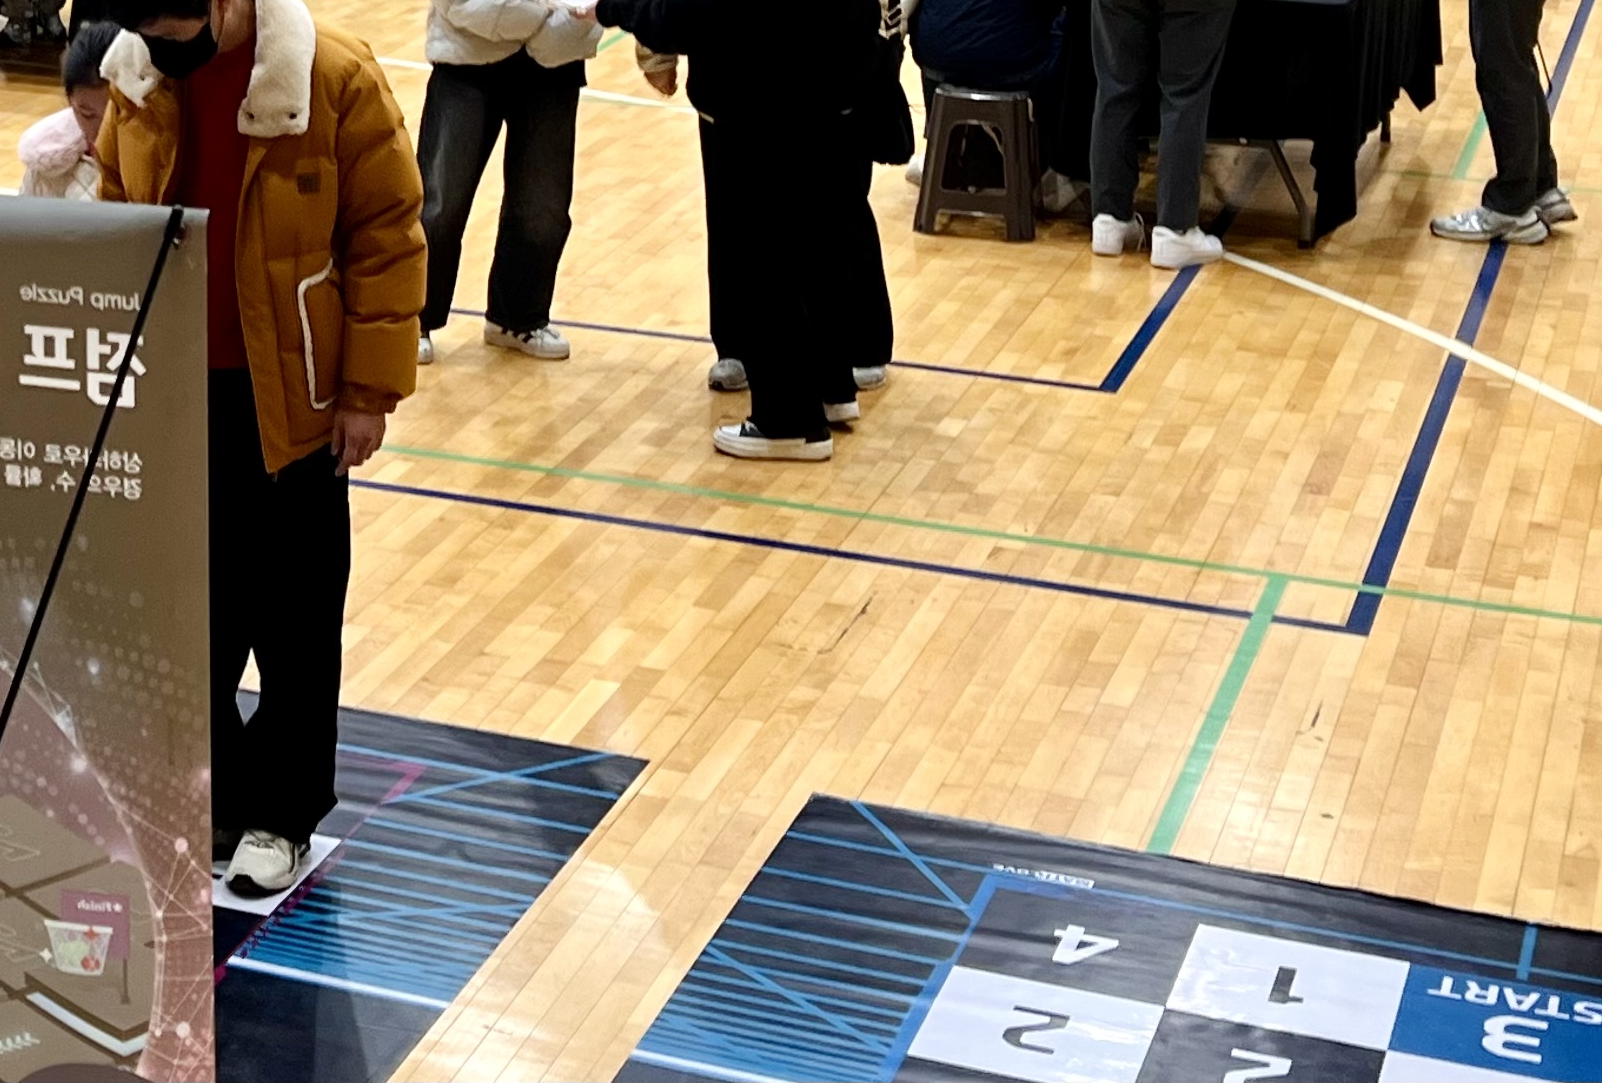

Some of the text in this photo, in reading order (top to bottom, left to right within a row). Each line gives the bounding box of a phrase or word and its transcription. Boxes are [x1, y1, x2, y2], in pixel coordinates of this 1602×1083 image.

[1052, 924, 1120, 965] 4
[1268, 966, 1304, 1004] 1
[1426, 975, 1602, 1025] START
[1002, 1005, 1071, 1055] 2
[1481, 1014, 1549, 1065] 3
